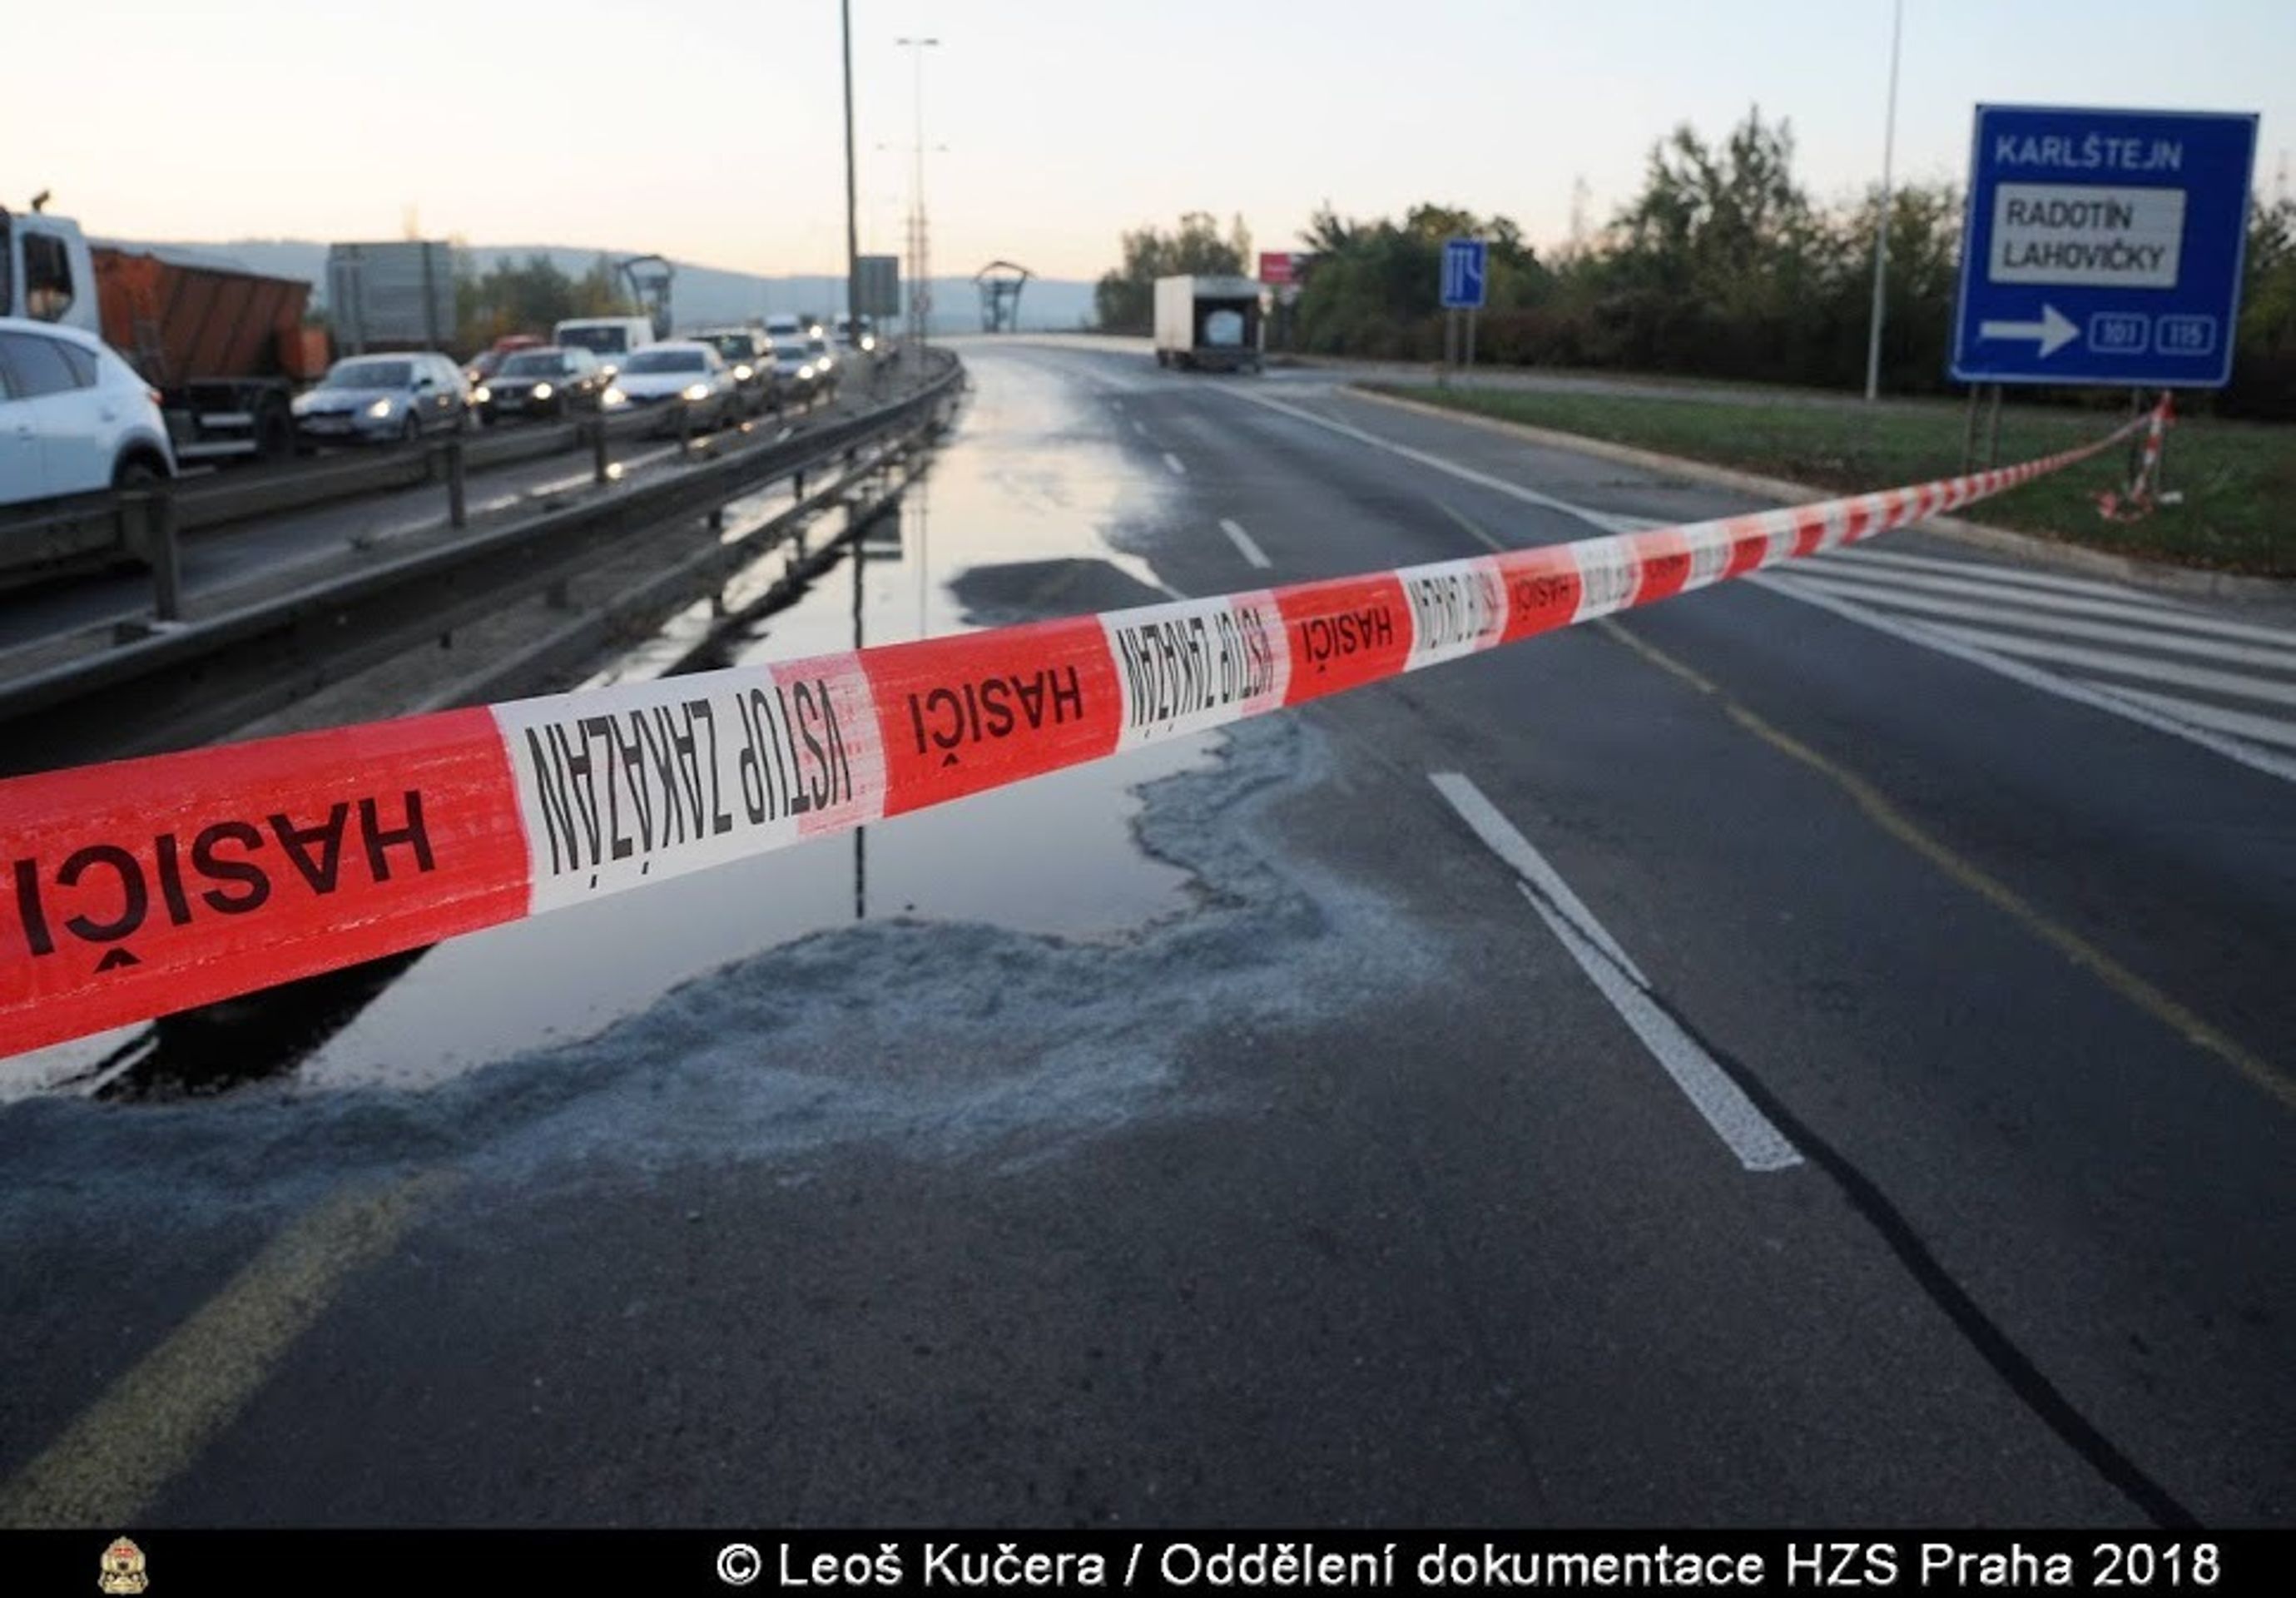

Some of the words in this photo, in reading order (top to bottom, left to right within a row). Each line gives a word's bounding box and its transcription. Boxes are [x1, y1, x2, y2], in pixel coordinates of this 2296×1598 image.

[1995, 132, 2183, 171] KARLŠTEJN
[2003, 239, 2166, 271] LAHOVIČKY
[2006, 197, 2134, 230] RADOTÍN
[1117, 618, 1214, 739] ZAKÁZÁN
[1214, 608, 1274, 704] VSTUP
[1301, 606, 1393, 672] HASIČI
[736, 679, 852, 825] VSTUP
[908, 665, 1084, 767] HASIČI
[525, 698, 732, 889] ZAKÁZÁN
[13, 790, 435, 974] HASIČI
